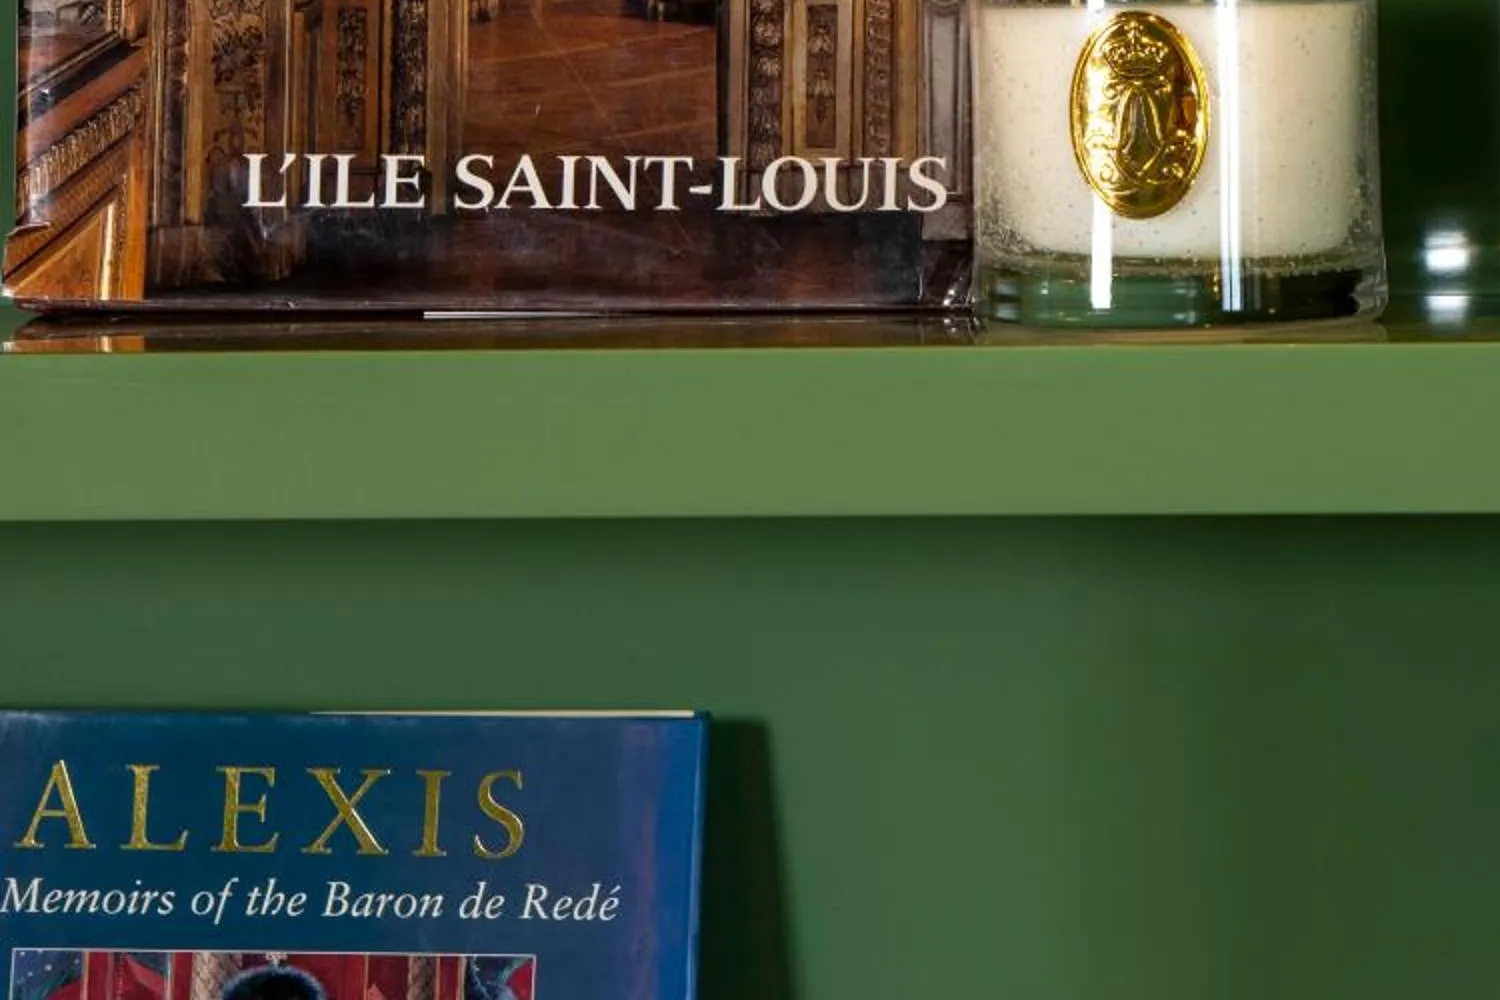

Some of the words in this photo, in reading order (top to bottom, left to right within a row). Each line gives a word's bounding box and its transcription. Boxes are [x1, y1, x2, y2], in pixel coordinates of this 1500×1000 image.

[241, 153, 425, 209] L'ILE
[453, 154, 949, 213] SAINT-LOUIS
[13, 758, 526, 858] ALEXIS
[0, 876, 176, 916] Memoirs
[190, 876, 240, 925] of
[246, 878, 307, 917] the
[322, 880, 444, 919] Baron
[458, 881, 505, 919] de
[519, 881, 621, 921] Redé
